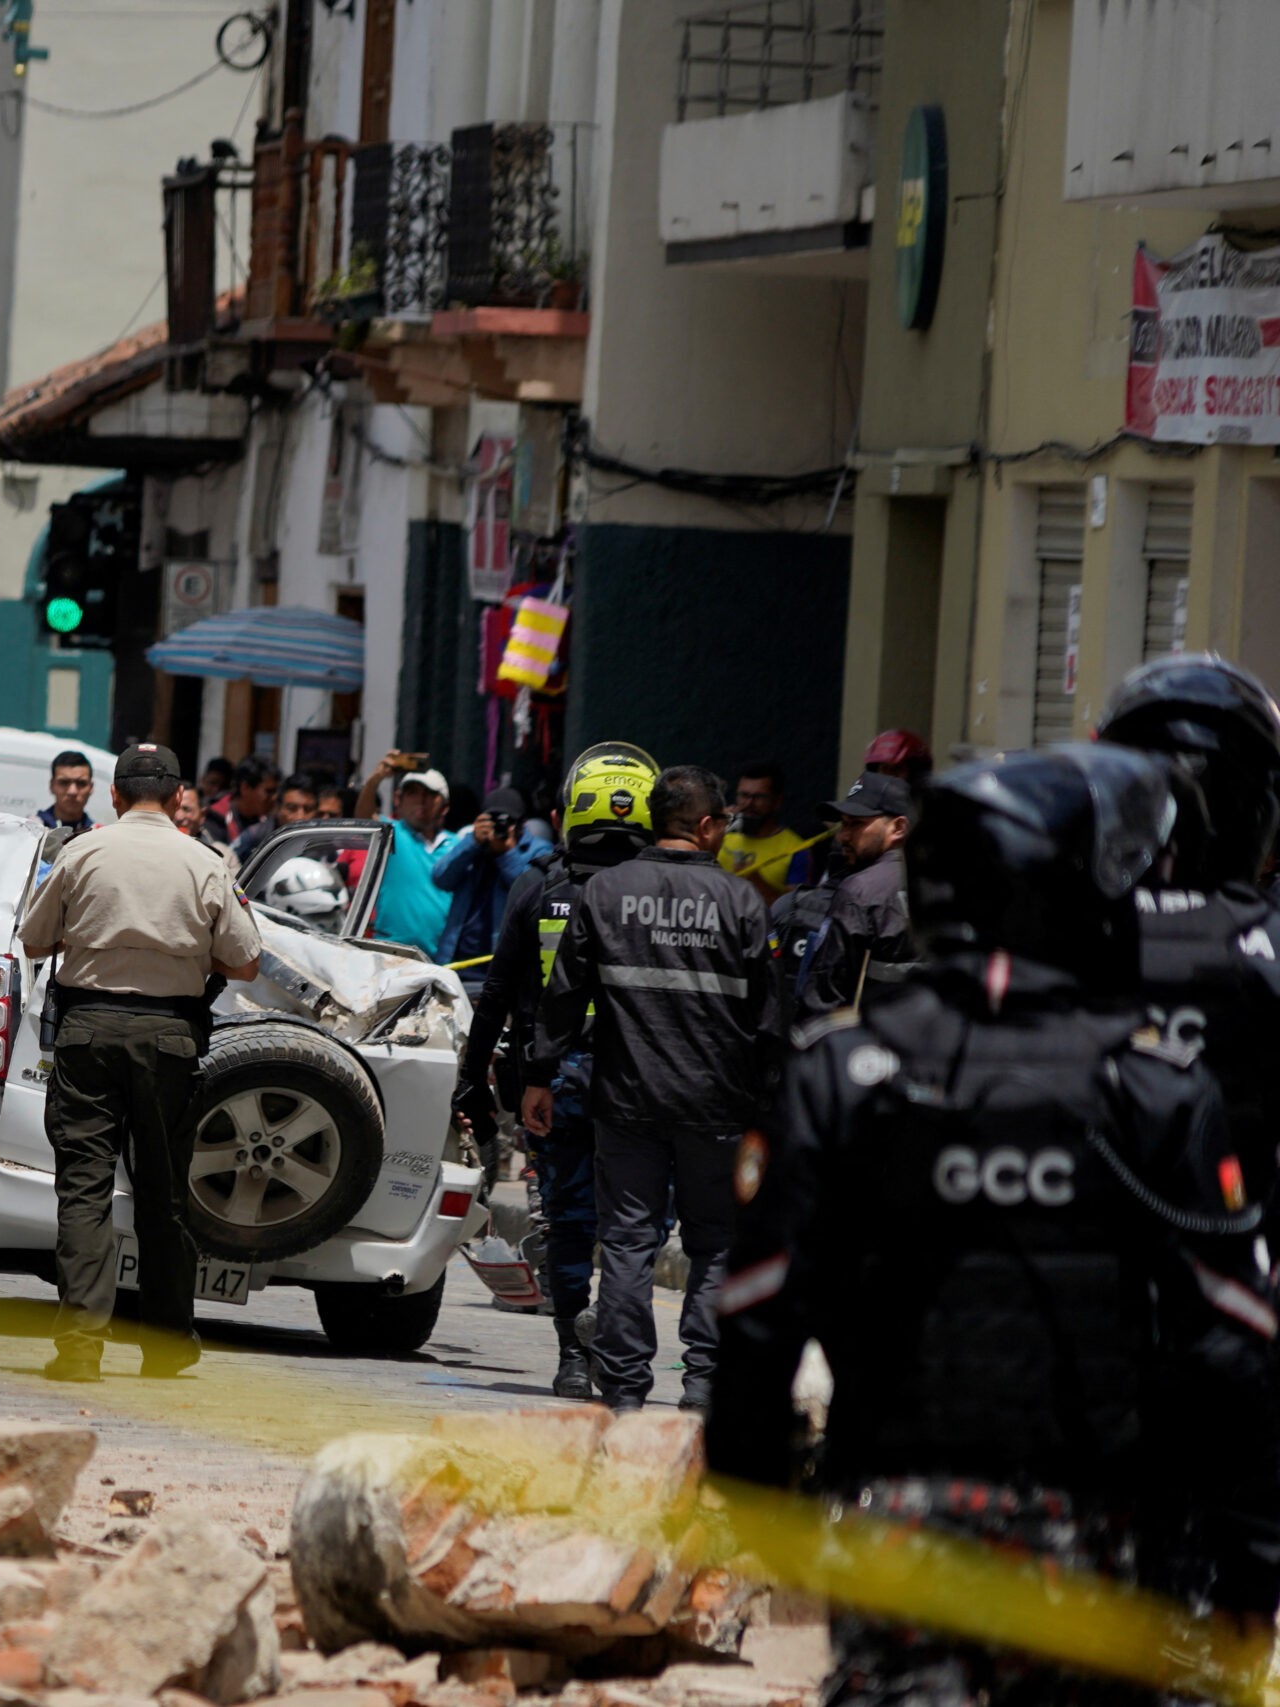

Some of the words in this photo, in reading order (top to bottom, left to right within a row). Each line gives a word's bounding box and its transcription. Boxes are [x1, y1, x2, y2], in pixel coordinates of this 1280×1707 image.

[604, 776, 643, 789] emov
[620, 892, 721, 930] POLICÍA
[650, 929, 719, 950] NACIONAL
[933, 1145, 1076, 1207] GCC
[118, 1253, 140, 1284] P
[199, 1265, 246, 1298] 147
